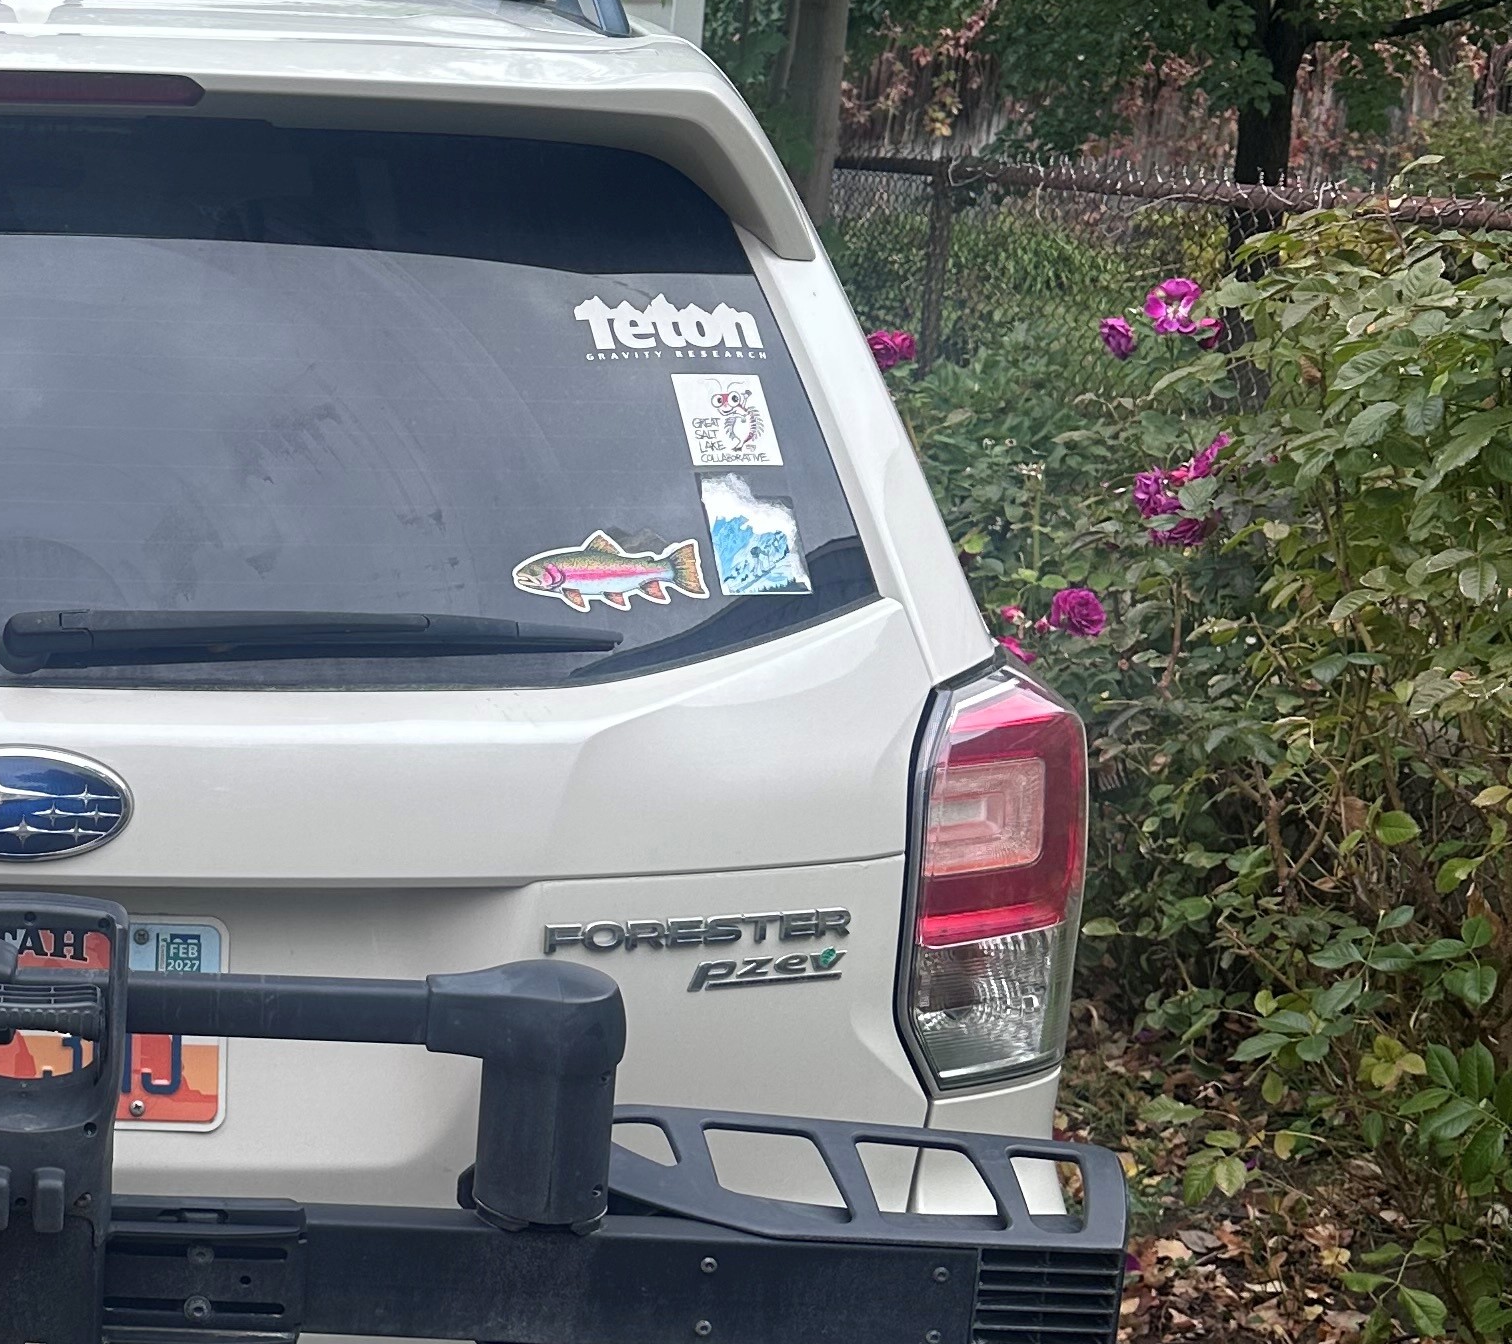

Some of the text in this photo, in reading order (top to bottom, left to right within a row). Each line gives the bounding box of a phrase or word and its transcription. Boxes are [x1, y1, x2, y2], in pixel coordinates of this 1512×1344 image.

[586, 349, 768, 361] GRAVITY RESEARCH
[692, 417, 721, 429] GREAT
[694, 430, 719, 440] SALT
[699, 440, 727, 453] LAKE
[701, 452, 770, 463] COLLABORATIVE
[543, 906, 852, 955] FORESTER
[169, 944, 199, 958] FEB
[166, 959, 200, 972] 2027
